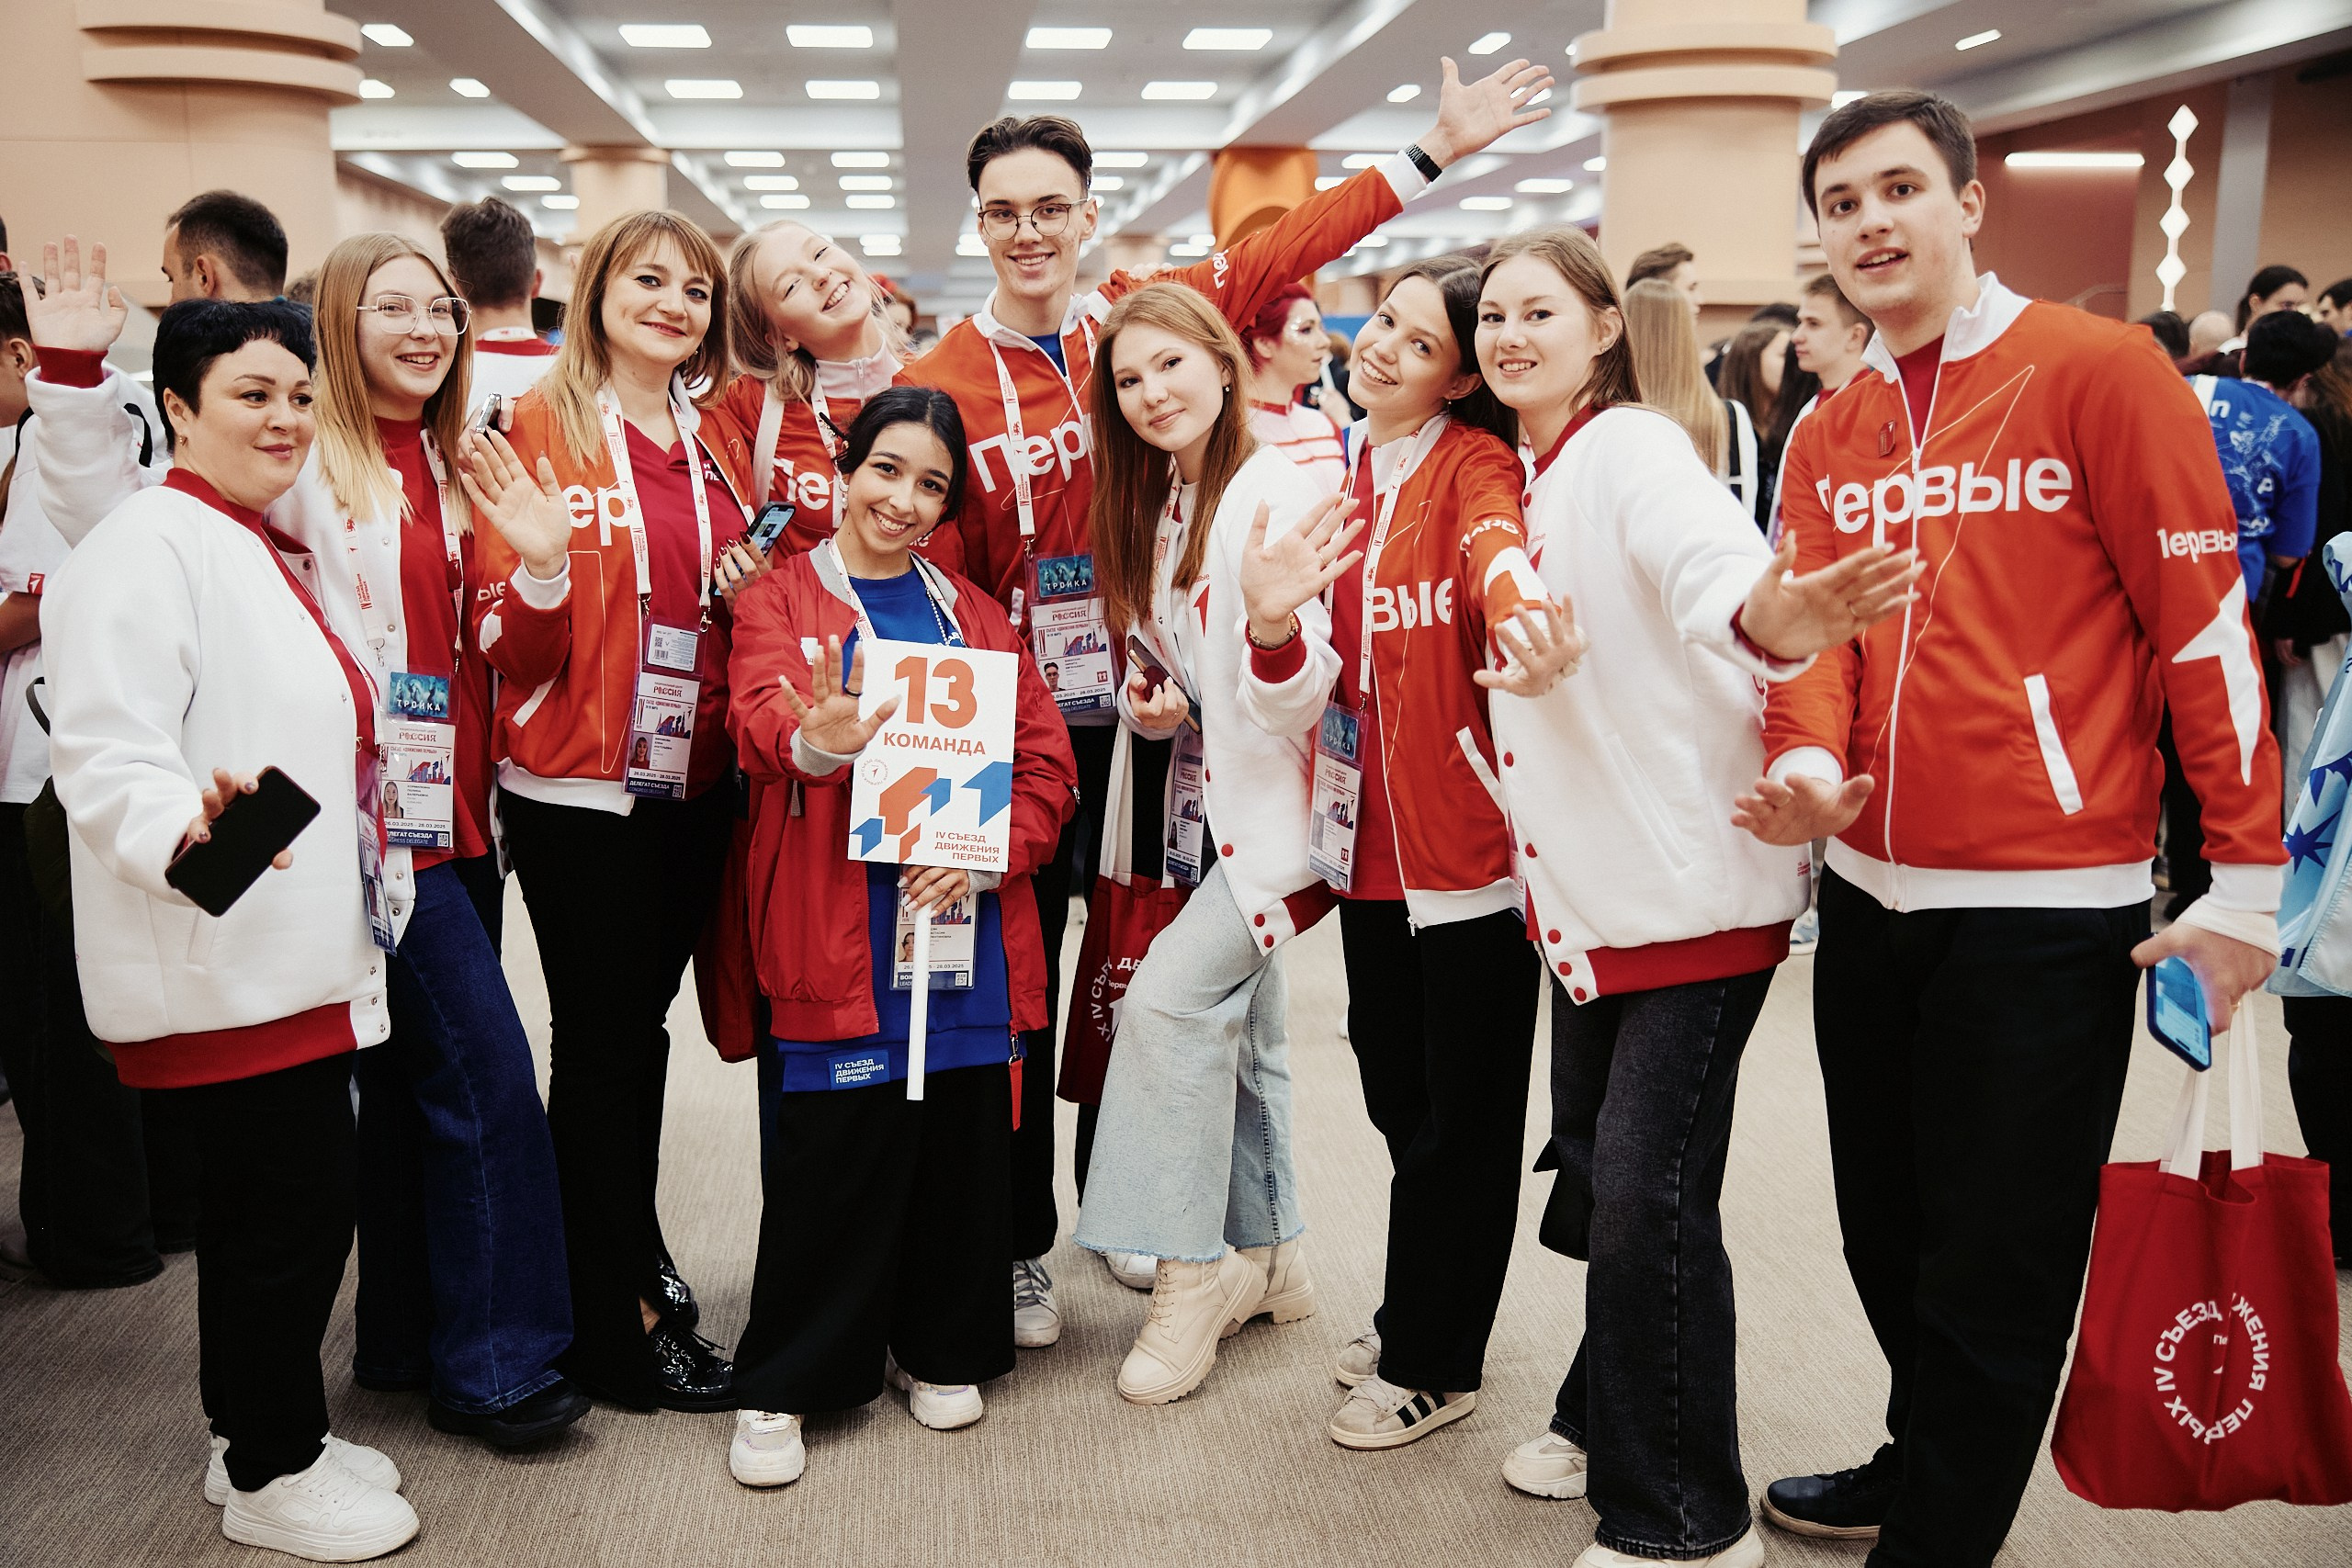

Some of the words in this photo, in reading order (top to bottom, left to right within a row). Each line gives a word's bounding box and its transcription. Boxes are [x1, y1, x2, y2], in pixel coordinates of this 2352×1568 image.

[968, 420, 1089, 493] Пер
[1046, 579, 1087, 591] ТРОЙКА
[1052, 610, 1087, 621] РОССИЯ
[894, 655, 978, 728] 13
[397, 699, 441, 712] ТРОЙКА
[399, 732, 436, 742] РОССИЯ
[884, 732, 986, 757] КОМАНДА
[935, 831, 946, 840] IV
[947, 832, 987, 843] СЪЕЗД
[934, 841, 1000, 854] ДВИЖЕНИЯ
[952, 852, 1000, 863] ПЕРВЫХ
[1091, 1002, 1103, 1020] IV
[844, 1058, 874, 1069] СЪЕЗД
[835, 1064, 885, 1078] ДВИЖЕНИЯ
[835, 1073, 872, 1084] ПЕРВЫХ
[2155, 1300, 2223, 1362] СЪЕЗД
[2231, 1293, 2269, 1392] ЖЕНИЯ
[2154, 1367, 2176, 1392] IV
